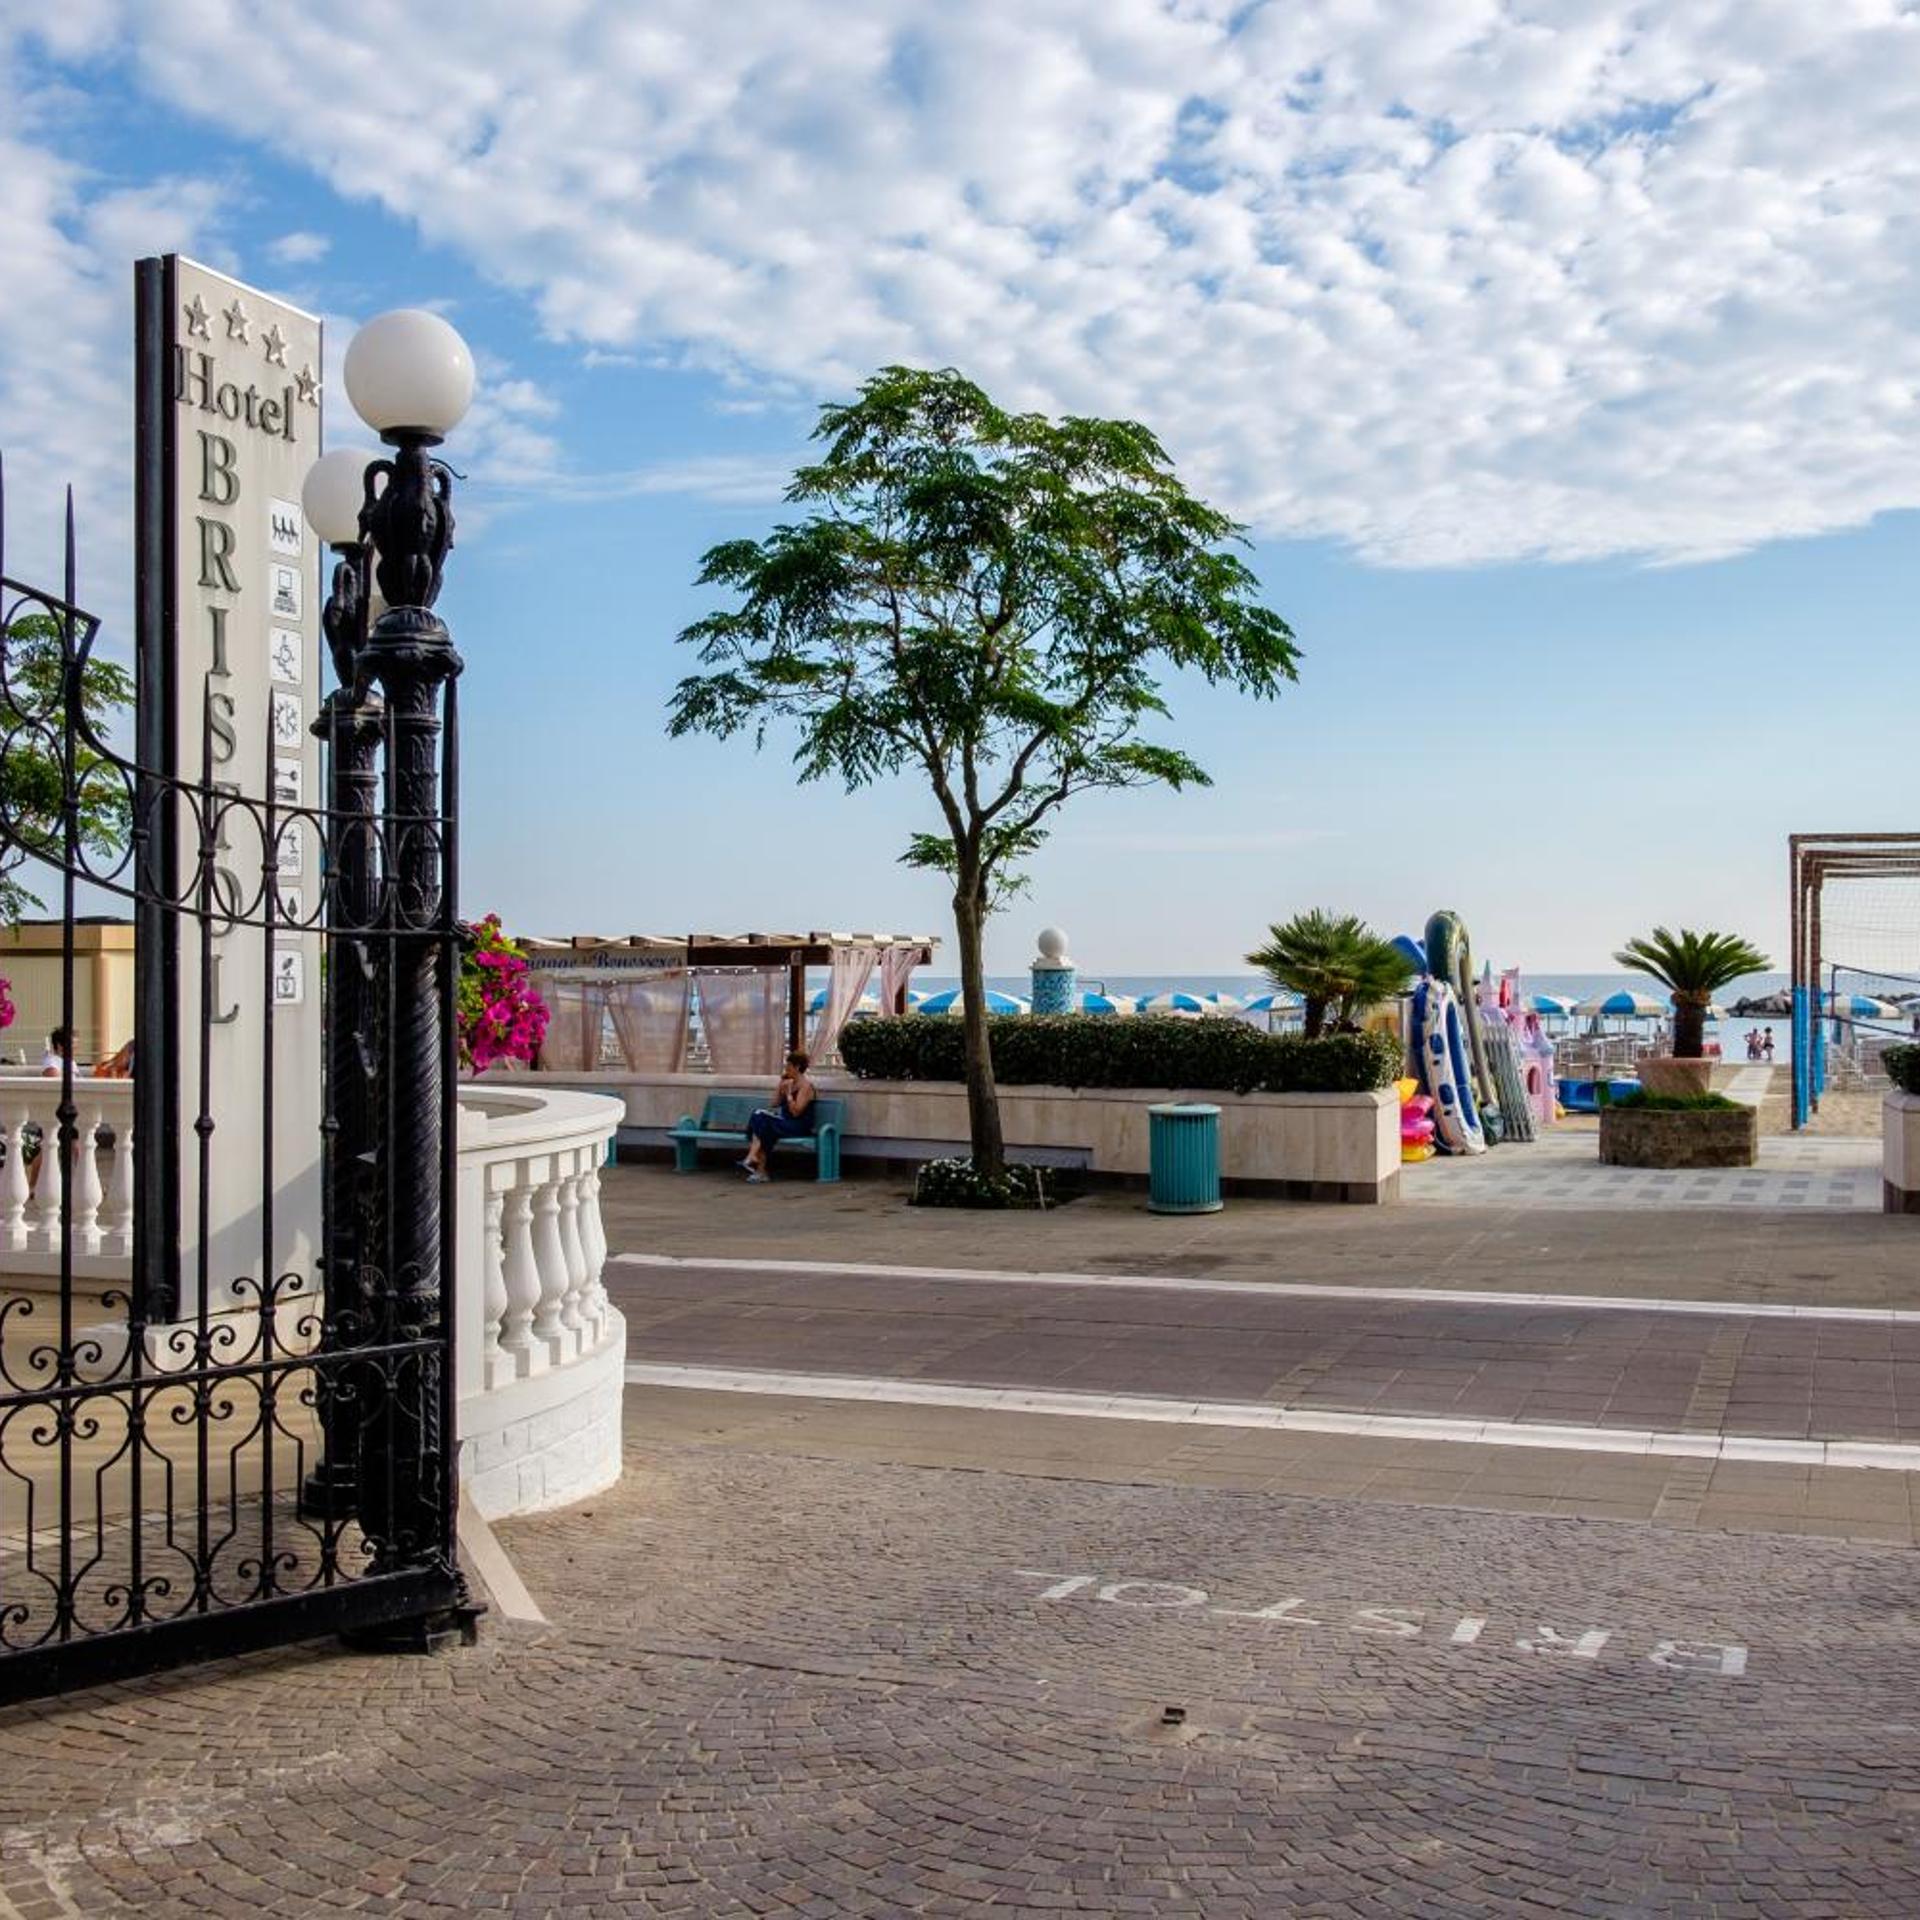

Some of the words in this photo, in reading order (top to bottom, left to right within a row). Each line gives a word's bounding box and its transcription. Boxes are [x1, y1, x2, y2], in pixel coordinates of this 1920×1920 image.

[174, 344, 298, 443] Hotel
[196, 430, 243, 1025] BRISTOL
[1014, 1570, 1749, 1675] BRISTOL
